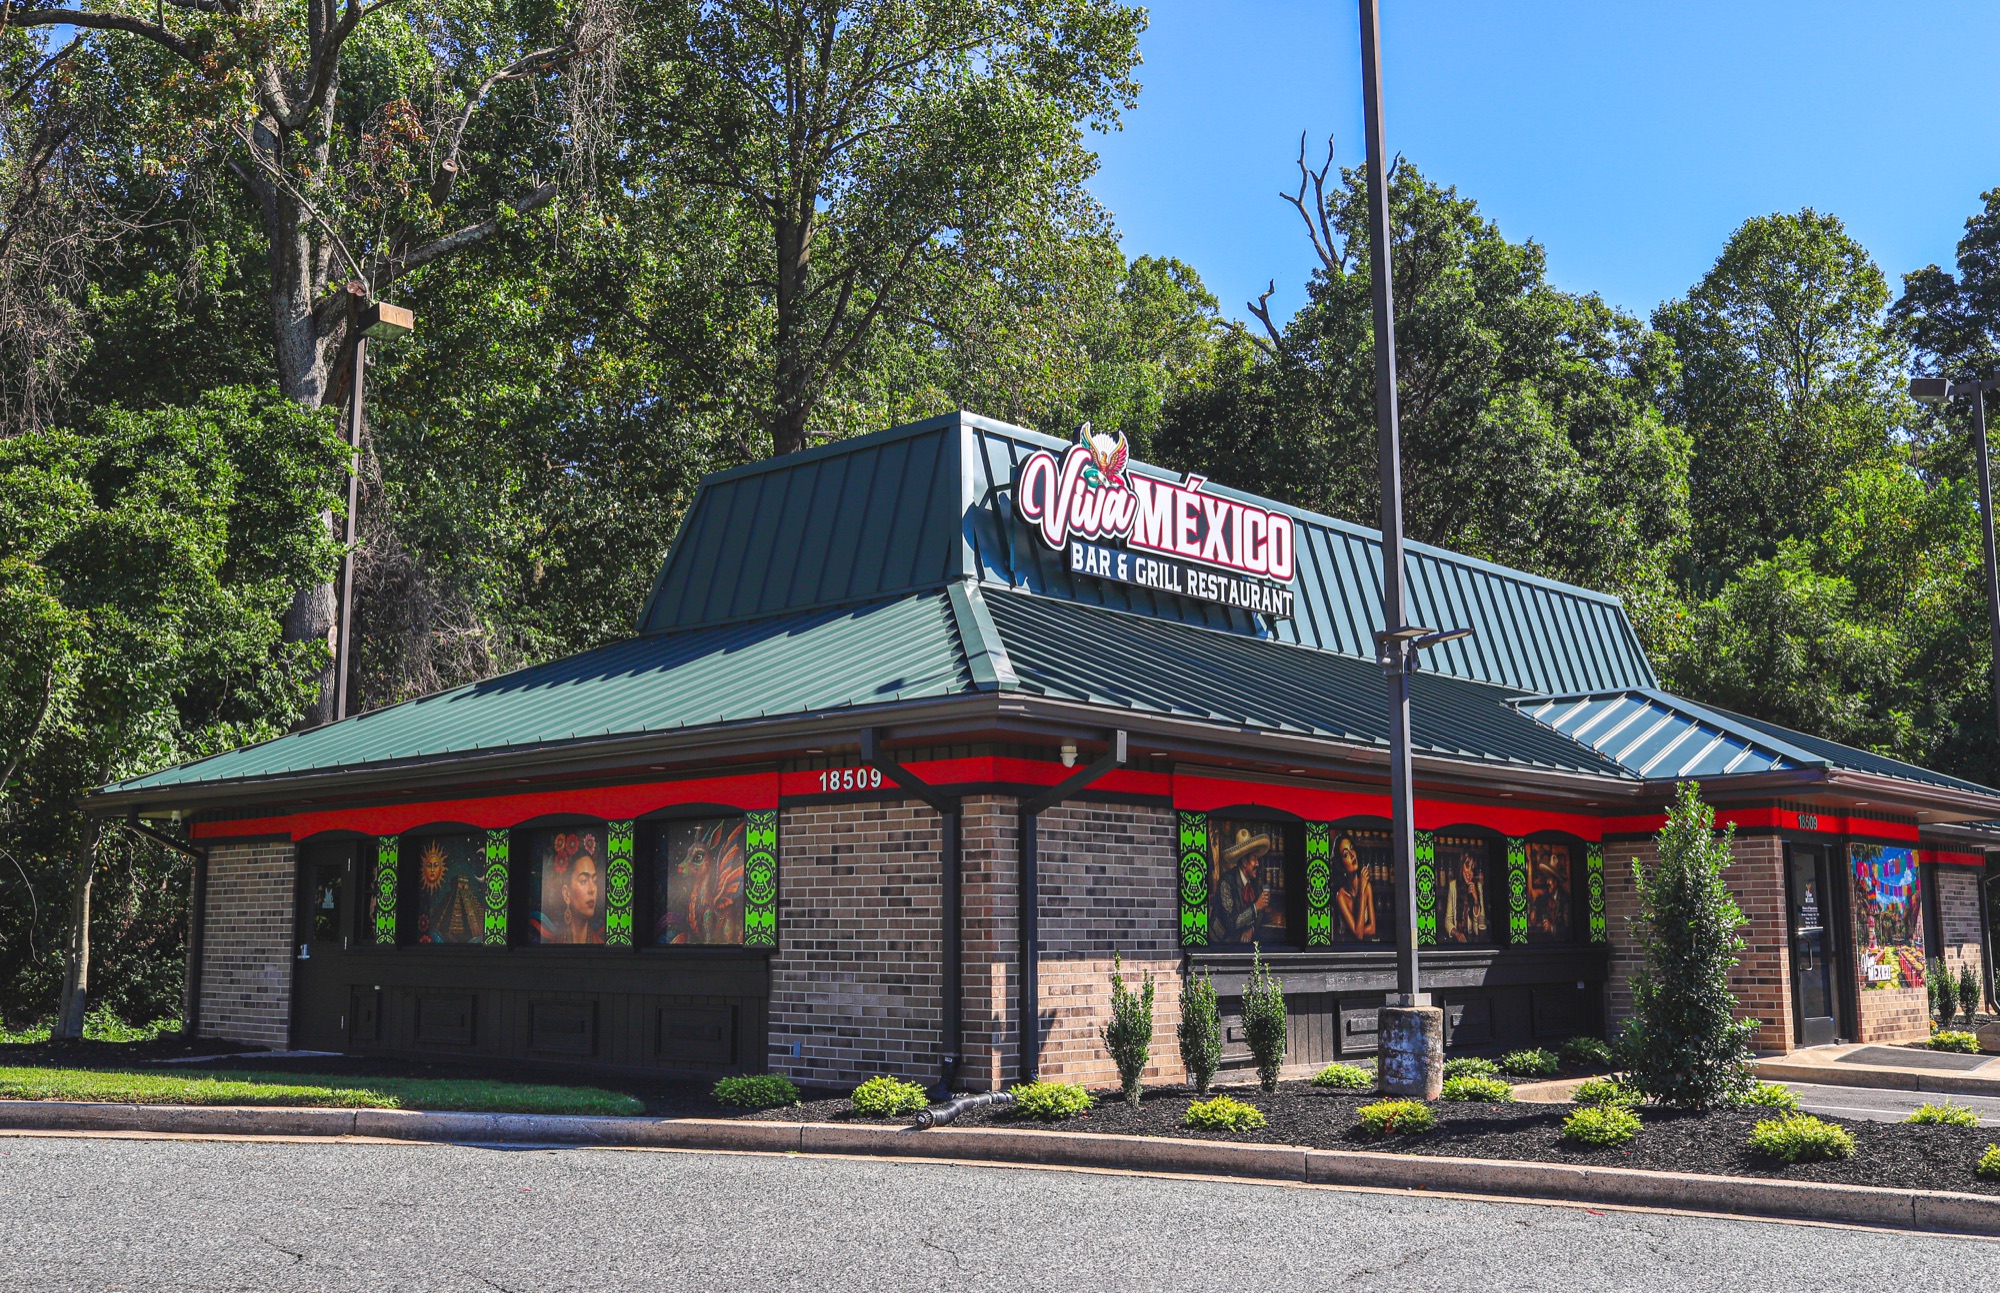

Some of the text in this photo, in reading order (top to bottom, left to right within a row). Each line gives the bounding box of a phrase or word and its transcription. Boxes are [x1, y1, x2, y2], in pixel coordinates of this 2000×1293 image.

[1020, 447, 1294, 580] Viva MÉXICO
[1071, 541, 1294, 617] BAR & GRILL RESTAURANT
[819, 768, 882, 791] 18509
[1798, 813, 1818, 831] 18509
